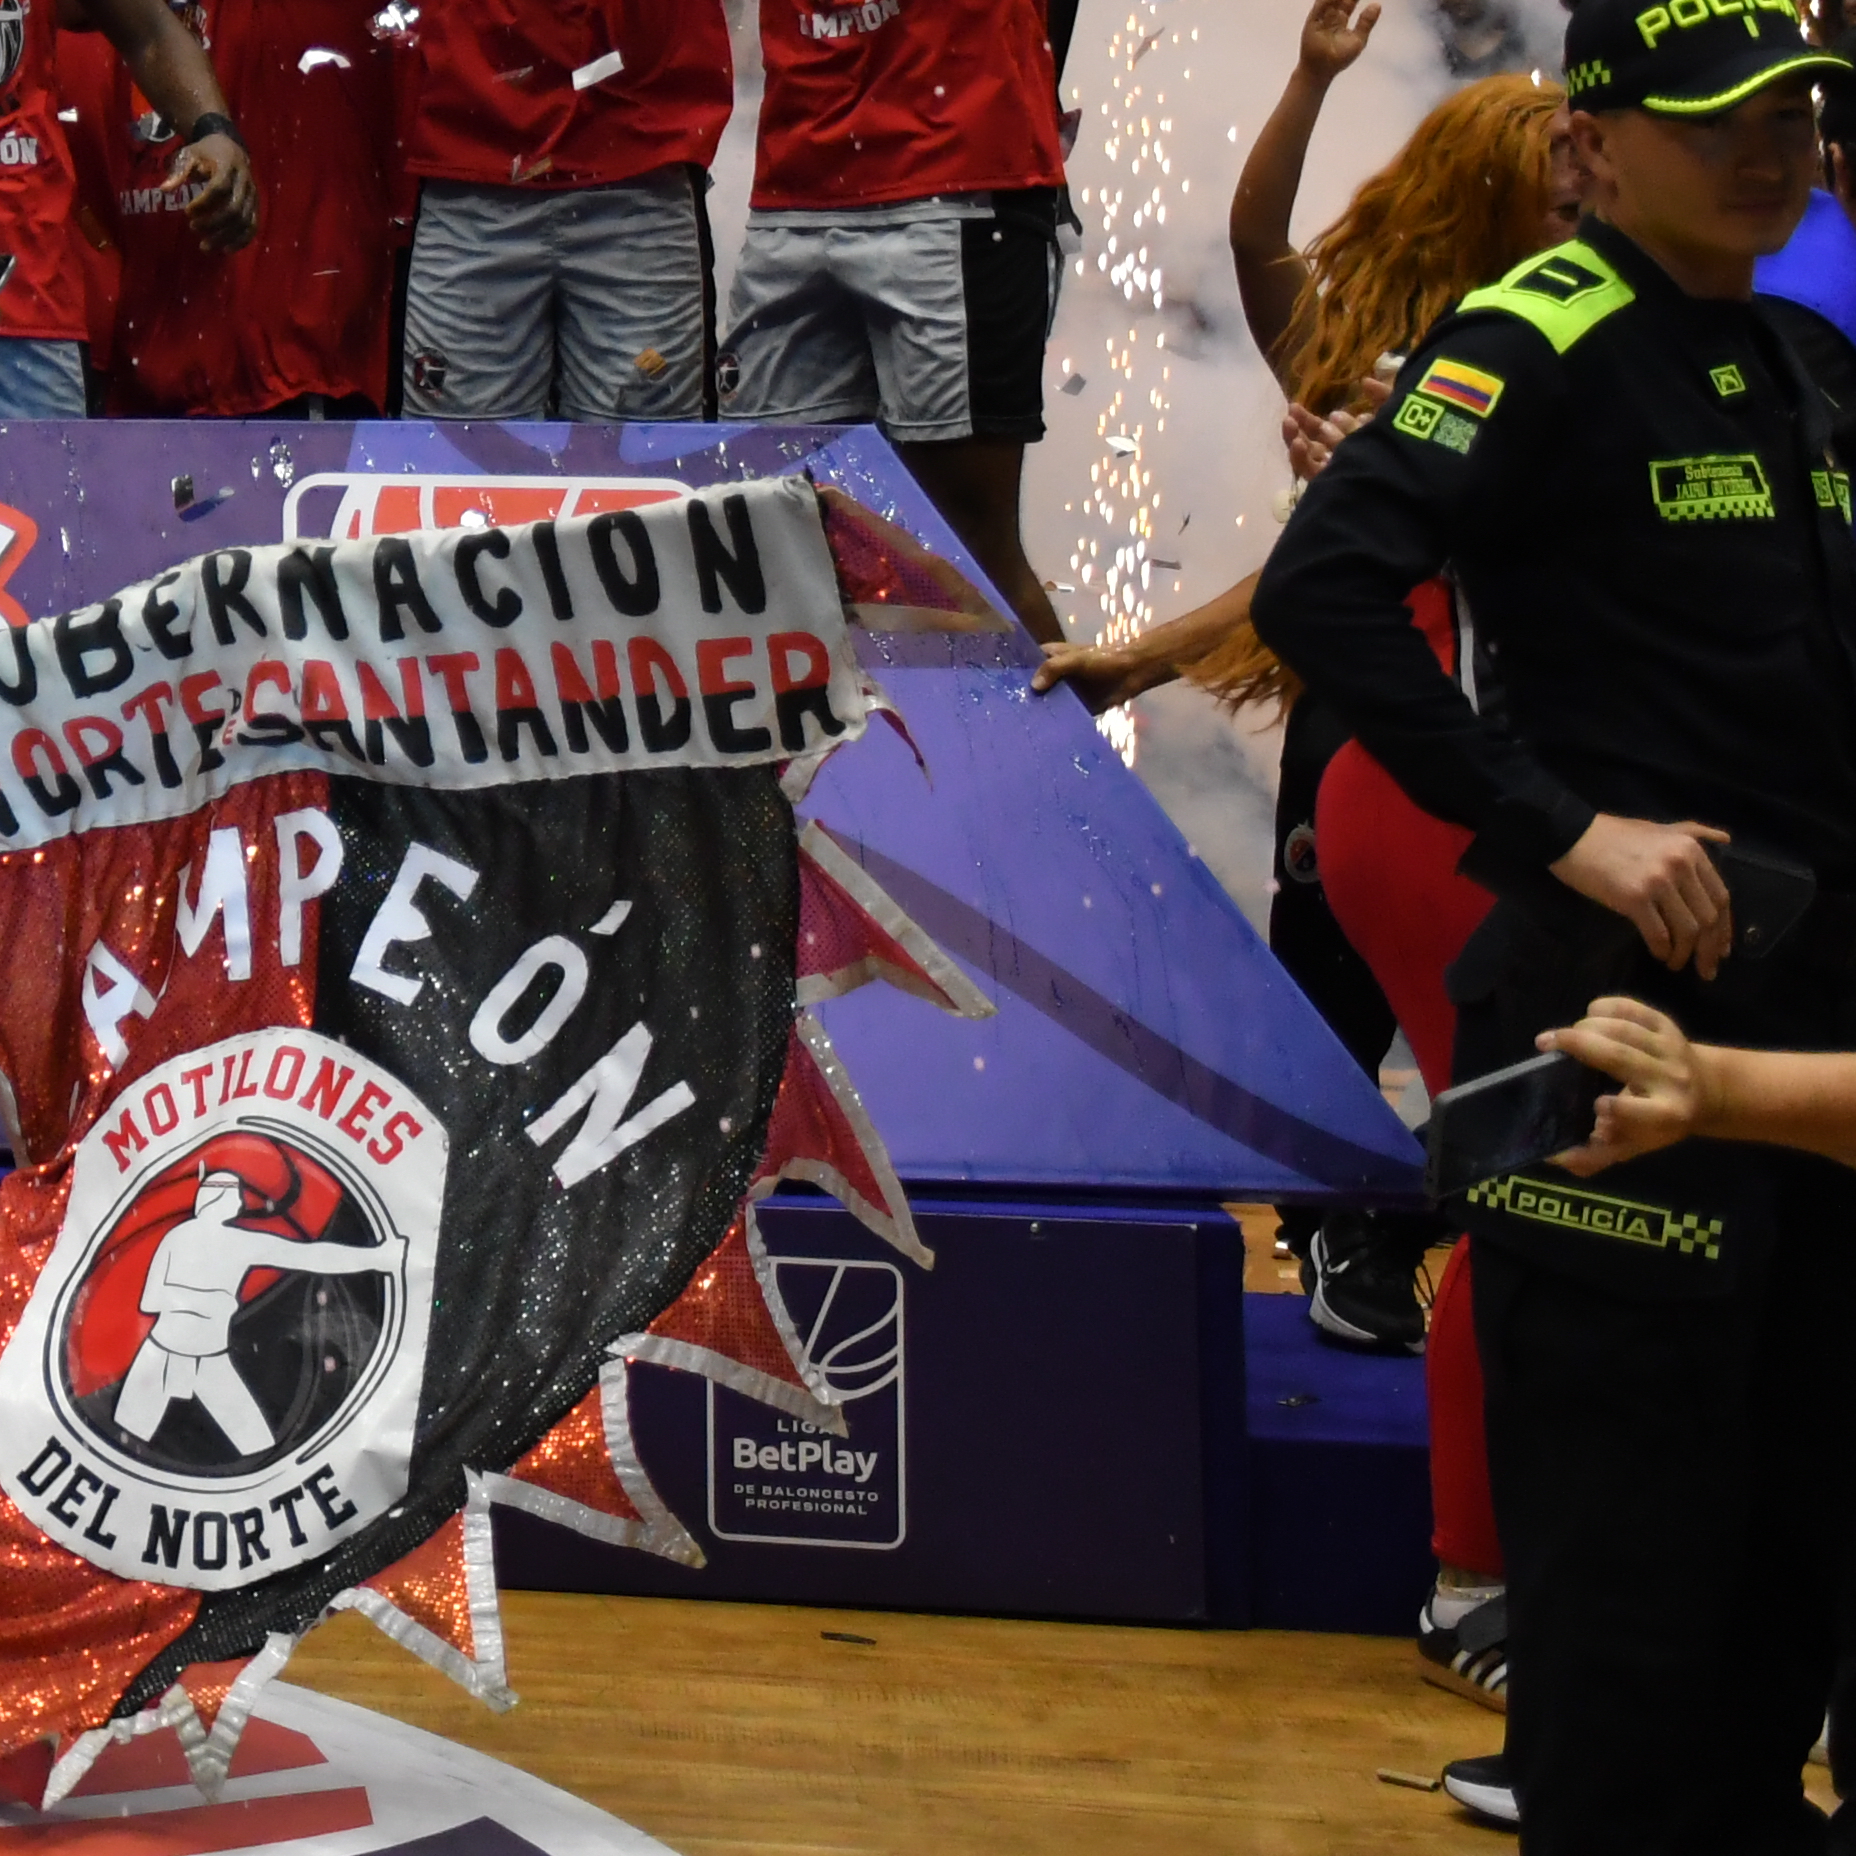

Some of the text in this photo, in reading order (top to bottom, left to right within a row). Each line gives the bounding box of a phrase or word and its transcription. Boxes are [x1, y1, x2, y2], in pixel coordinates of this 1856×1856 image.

[82, 804, 697, 1194] AMPEÓN
[101, 1044, 424, 1175] MOTILONES
[1515, 1190, 1654, 1243] POLICÍA
[732, 1437, 879, 1483] BetPlay
[15, 1435, 360, 1573] DEL NORTE
[733, 1484, 880, 1503] DE BALONCESTO
[745, 1498, 869, 1516] PROFESIONAL
